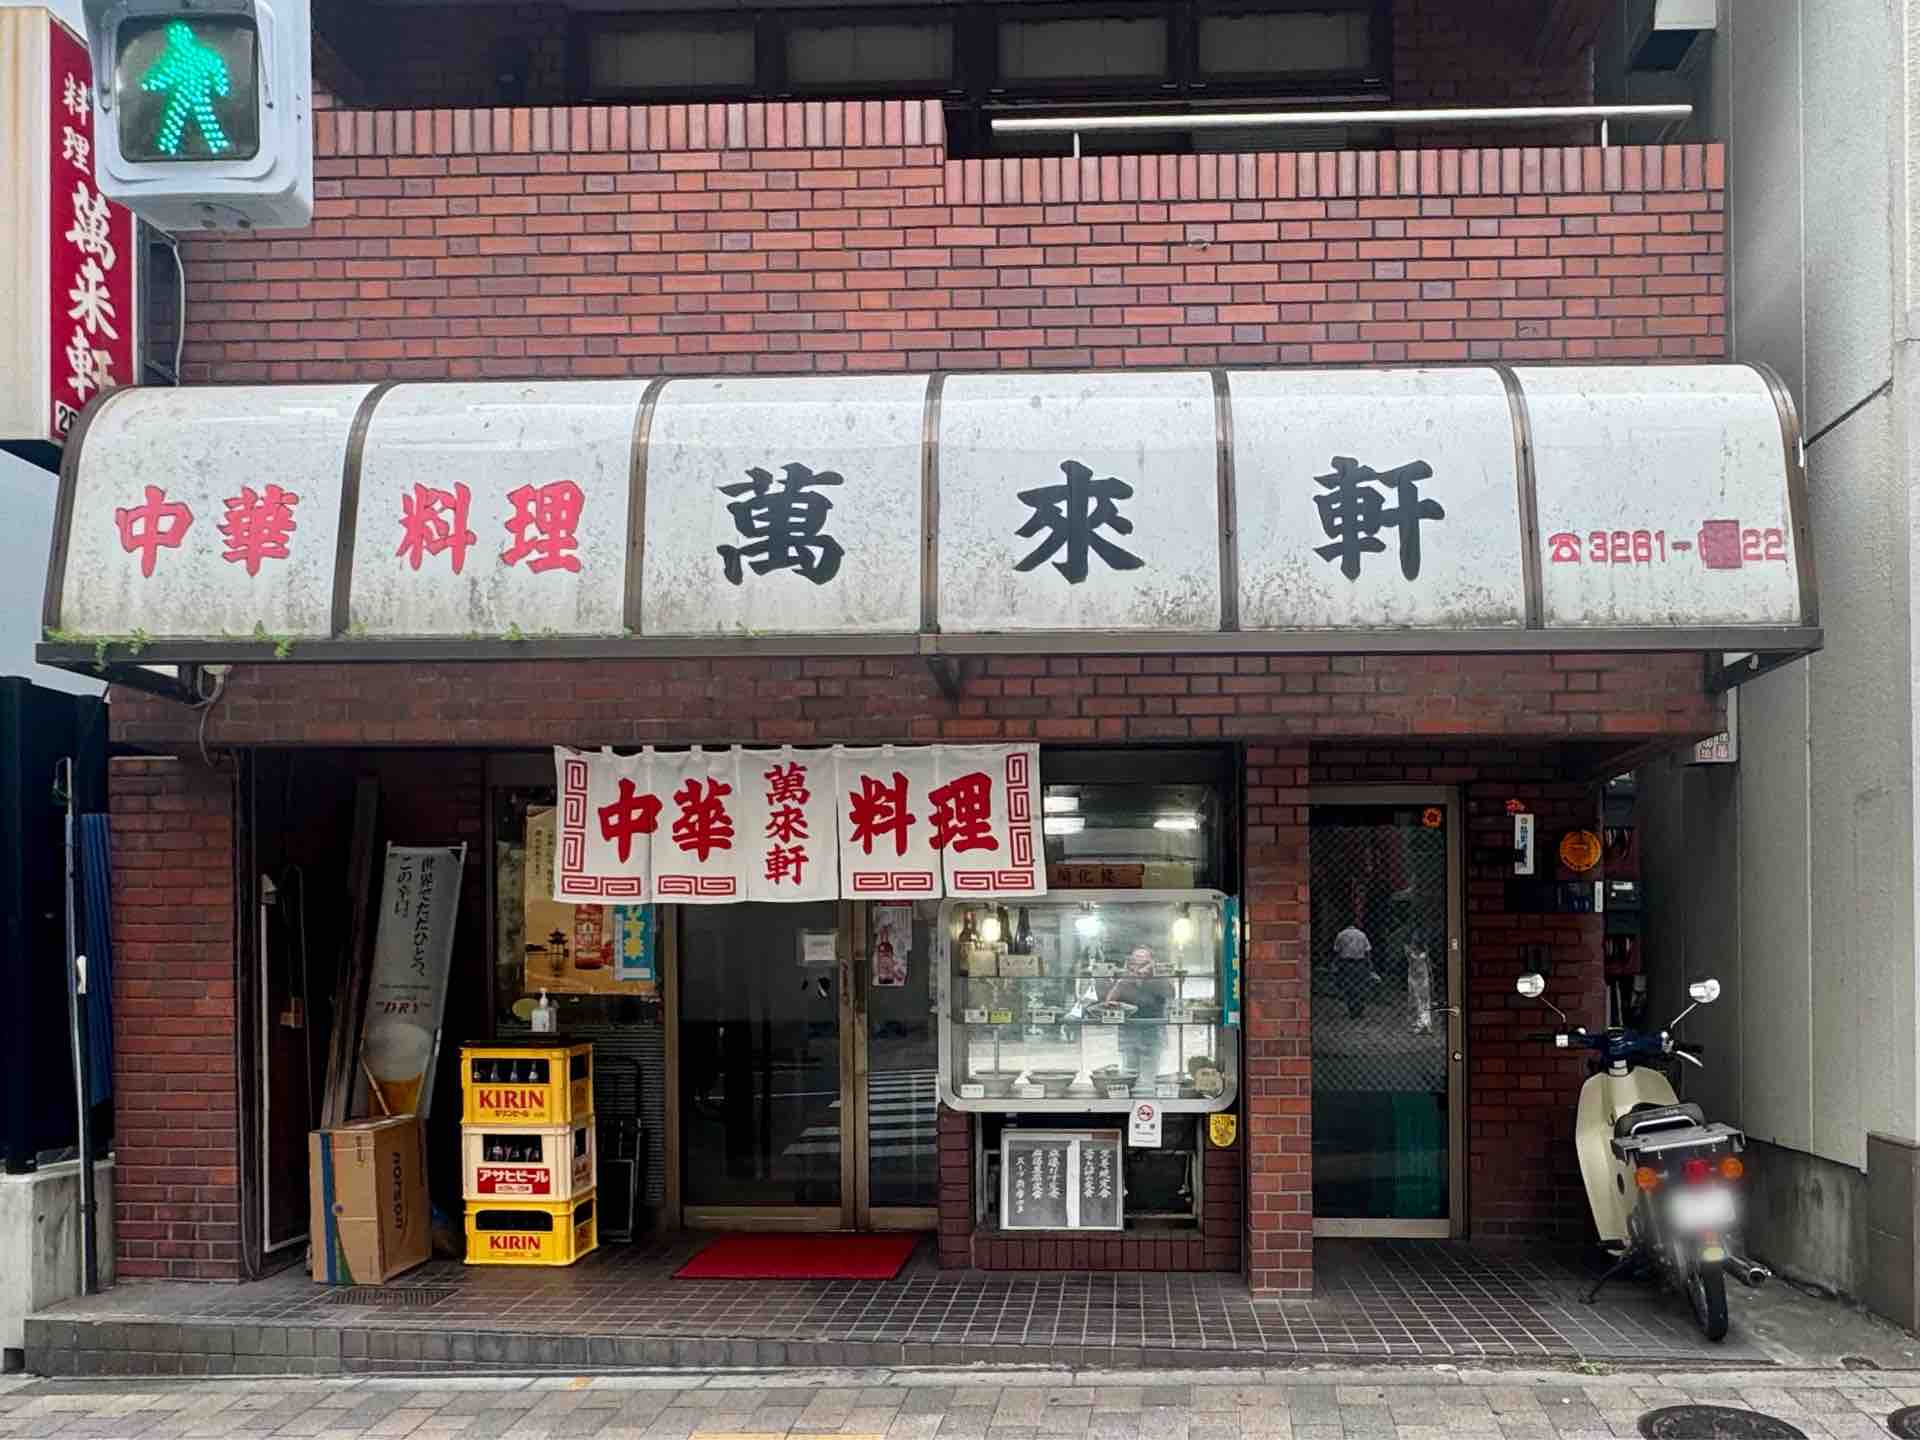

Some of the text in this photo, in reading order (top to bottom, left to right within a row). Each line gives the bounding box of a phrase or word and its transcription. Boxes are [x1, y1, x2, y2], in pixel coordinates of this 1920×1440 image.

[114, 457, 1445, 587] 中華料理 萬來軒
[1588, 528, 1787, 563] 3261-22
[597, 777, 736, 864] 中華
[848, 771, 1001, 856] 料理
[764, 761, 812, 886] 萬來軒
[479, 1089, 545, 1110] KIRIN
[479, 1168, 549, 1184] アサヒビール
[489, 1235, 541, 1250] KIRIN
